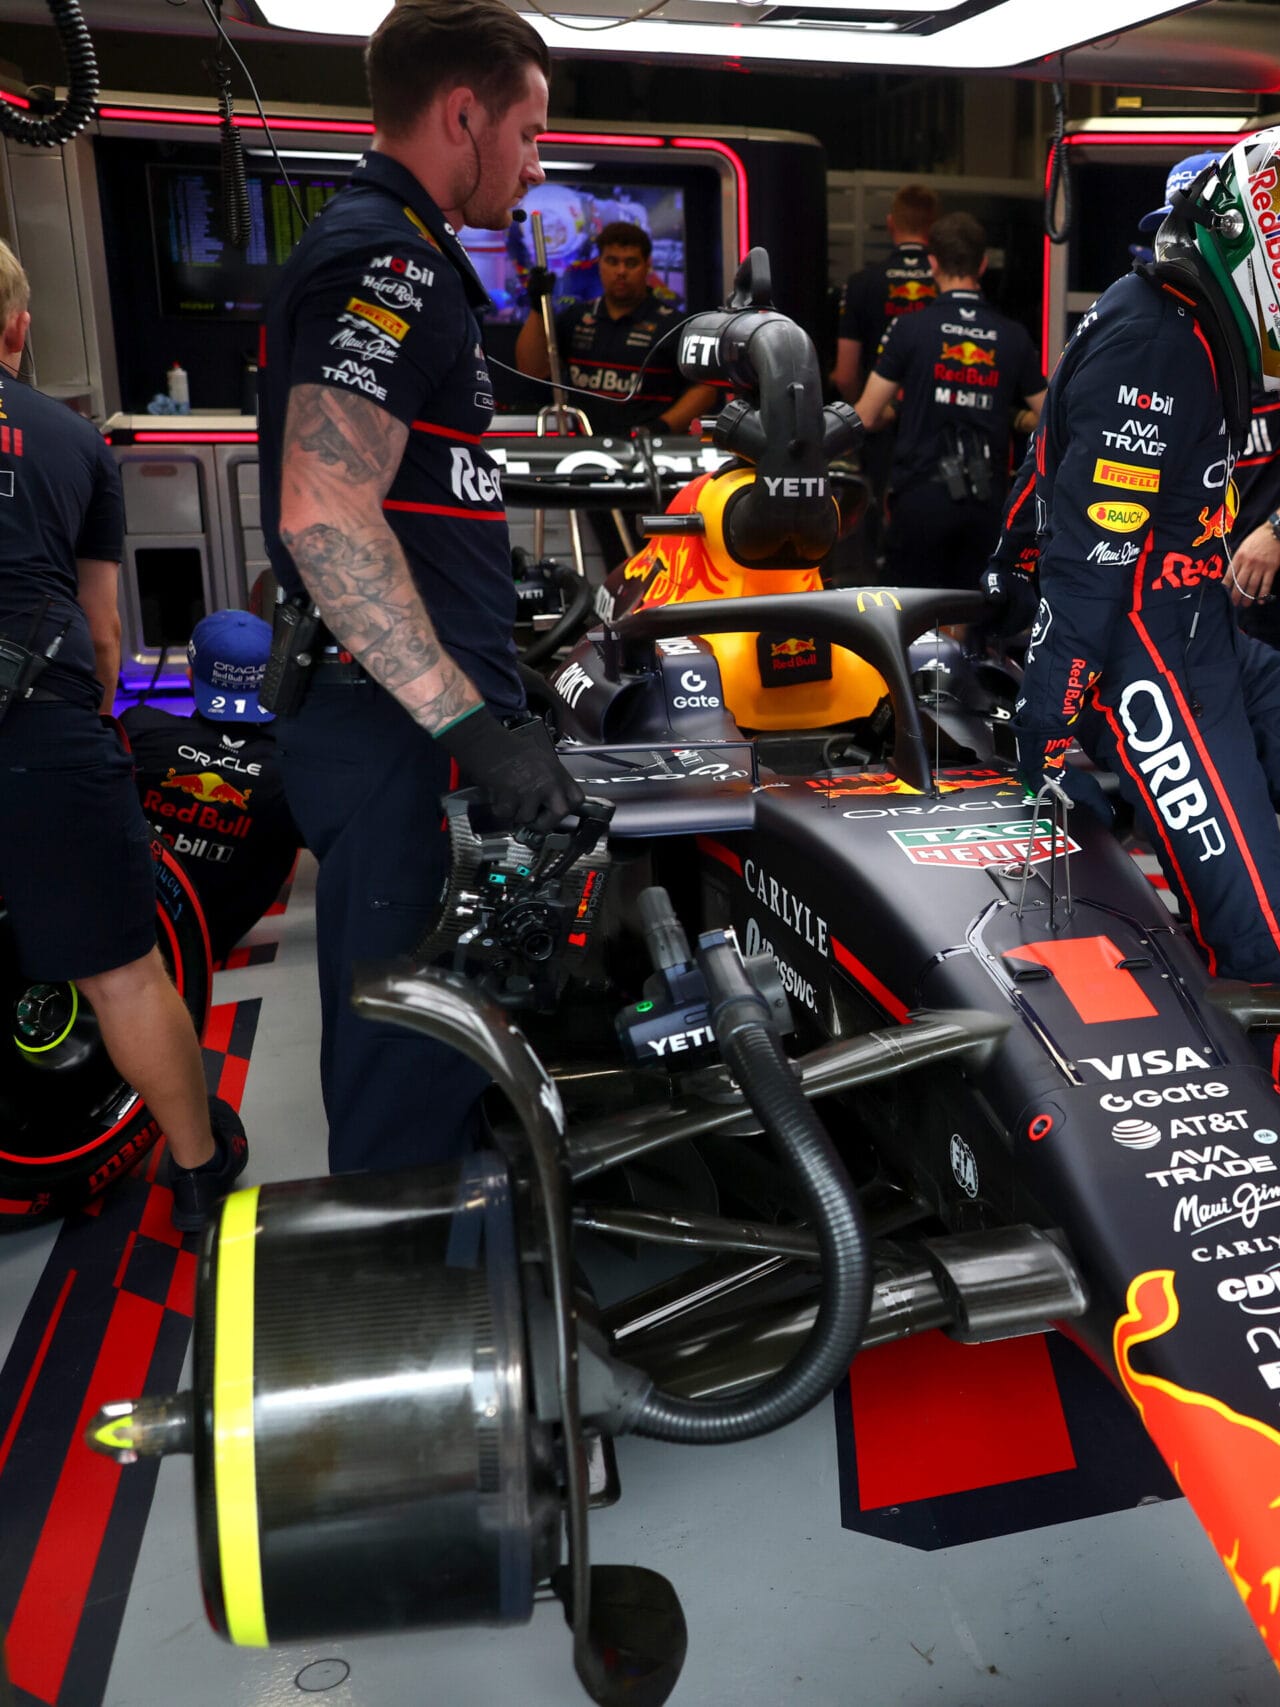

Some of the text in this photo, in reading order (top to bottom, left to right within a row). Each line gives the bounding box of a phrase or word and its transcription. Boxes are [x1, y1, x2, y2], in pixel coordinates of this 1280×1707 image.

[370, 255, 434, 287] Mobil
[362, 275, 423, 312] Hard Rock
[352, 303, 403, 335] PIRELLI
[940, 323, 997, 341] ORACLE
[330, 329, 367, 350] Maui
[322, 366, 387, 401] TRADE
[339, 359, 377, 382] AVA
[934, 364, 965, 382] Red
[935, 387, 975, 408] Mobil
[1117, 385, 1174, 416] Mobil
[1120, 419, 1160, 439] AVA
[1102, 431, 1167, 457] TRADE
[763, 476, 825, 497] YETI
[1101, 465, 1159, 489] PIRELLI
[1107, 510, 1143, 524] RAUCH
[1087, 541, 1120, 561] Maui
[518, 589, 543, 600] YETI
[1062, 658, 1086, 715] Red Bull
[673, 694, 719, 709] Gate
[178, 745, 262, 776] ORACLE
[1119, 680, 1226, 862] ORBR
[143, 789, 253, 838] Red Bull
[843, 797, 1053, 819] ORACLE
[906, 820, 1048, 844] TAG
[916, 838, 1066, 862] HEUER
[744, 858, 829, 959] CARLYLE
[648, 1025, 714, 1056] YETI
[1078, 1046, 1211, 1081] VISA
[1131, 1081, 1230, 1108] Gate
[1169, 1109, 1250, 1139] AT&T
[88, 1121, 159, 1190] IRELLI
[1169, 1145, 1241, 1168] AVA
[1145, 1155, 1278, 1187] TRADE
[1173, 1197, 1230, 1233] Maui
